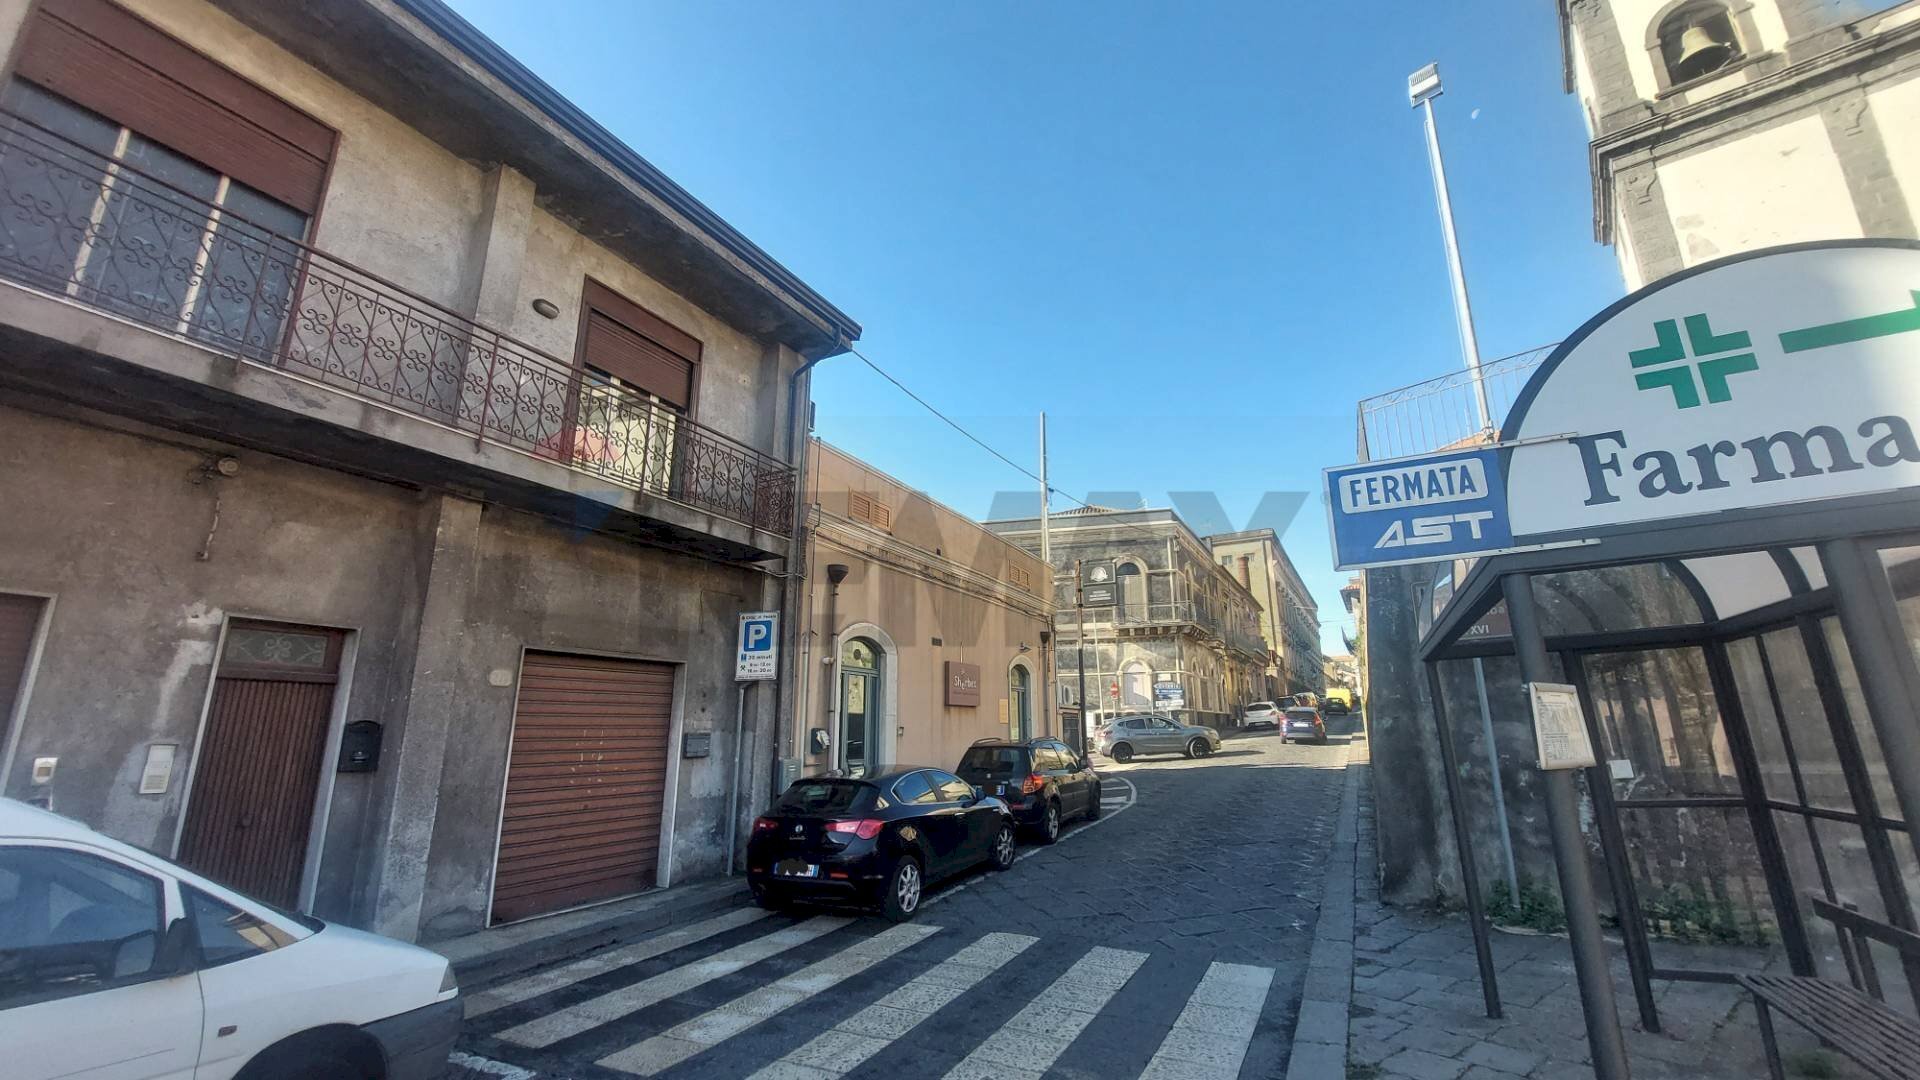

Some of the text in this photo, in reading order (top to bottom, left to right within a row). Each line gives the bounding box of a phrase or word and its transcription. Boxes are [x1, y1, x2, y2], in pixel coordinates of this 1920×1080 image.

[1568, 415, 1920, 507] Farma
[1350, 464, 1477, 508] FERMATA
[1374, 510, 1494, 549] AST
[748, 624, 767, 649] P
